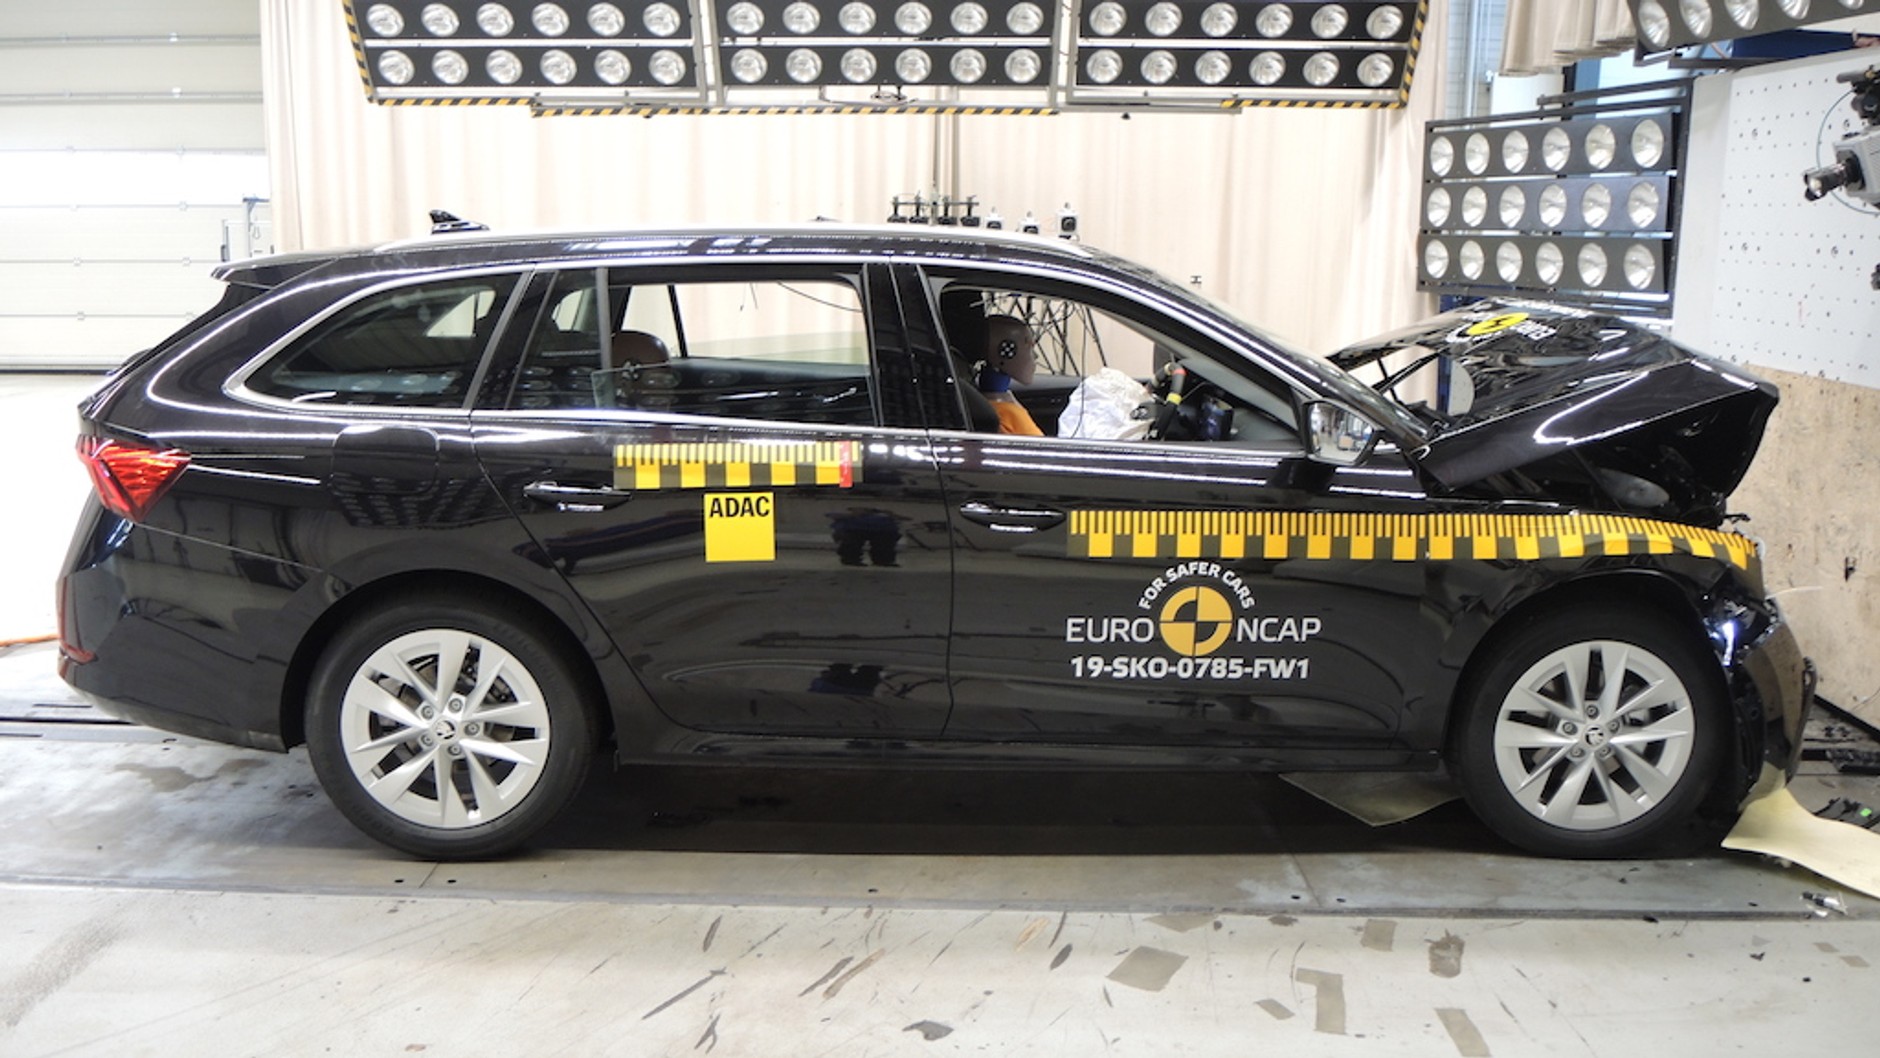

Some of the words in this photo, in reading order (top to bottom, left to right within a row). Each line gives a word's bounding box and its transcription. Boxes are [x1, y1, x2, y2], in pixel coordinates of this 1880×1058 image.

[709, 496, 770, 518] ADAC
[1138, 577, 1167, 610] FOR
[1165, 561, 1221, 582] SAFER
[1221, 571, 1256, 610] CARS
[1066, 617, 1154, 643] EURO
[1236, 617, 1321, 643] NCAP
[1070, 656, 1309, 679] 19-SKO-0785-FW1
